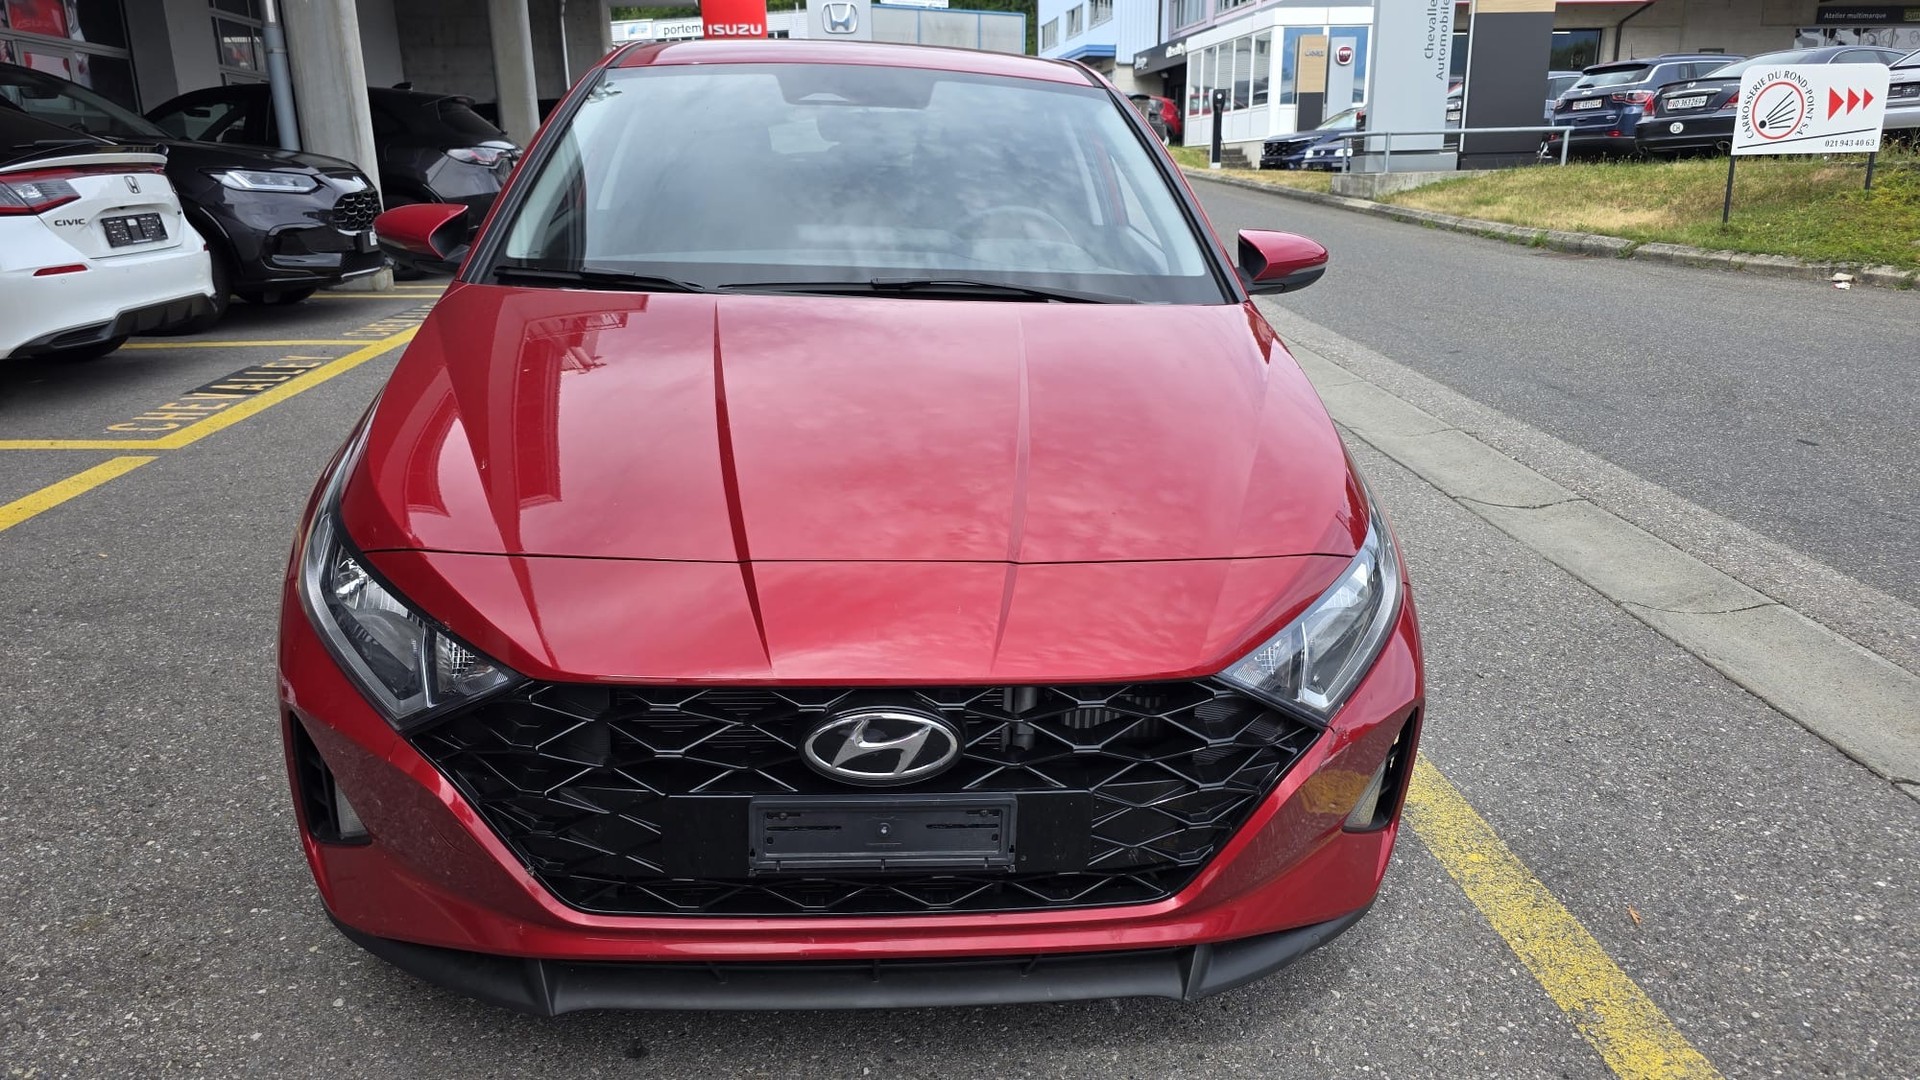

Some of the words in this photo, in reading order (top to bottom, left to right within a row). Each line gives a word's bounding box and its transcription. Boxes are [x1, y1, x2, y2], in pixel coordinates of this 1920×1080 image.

[708, 23, 762, 35] ISUZU
[1741, 78, 1767, 139] CARROSSERIE
[1767, 70, 1782, 82] DU
[1783, 70, 1815, 120] ROND-POINT
[1824, 139, 1839, 148] 021
[1839, 139, 1854, 147] 943
[1855, 139, 1864, 147] 40
[1865, 138, 1876, 147] 63
[54, 218, 86, 227] CIVIC
[106, 355, 334, 432] CHEVALLEY
